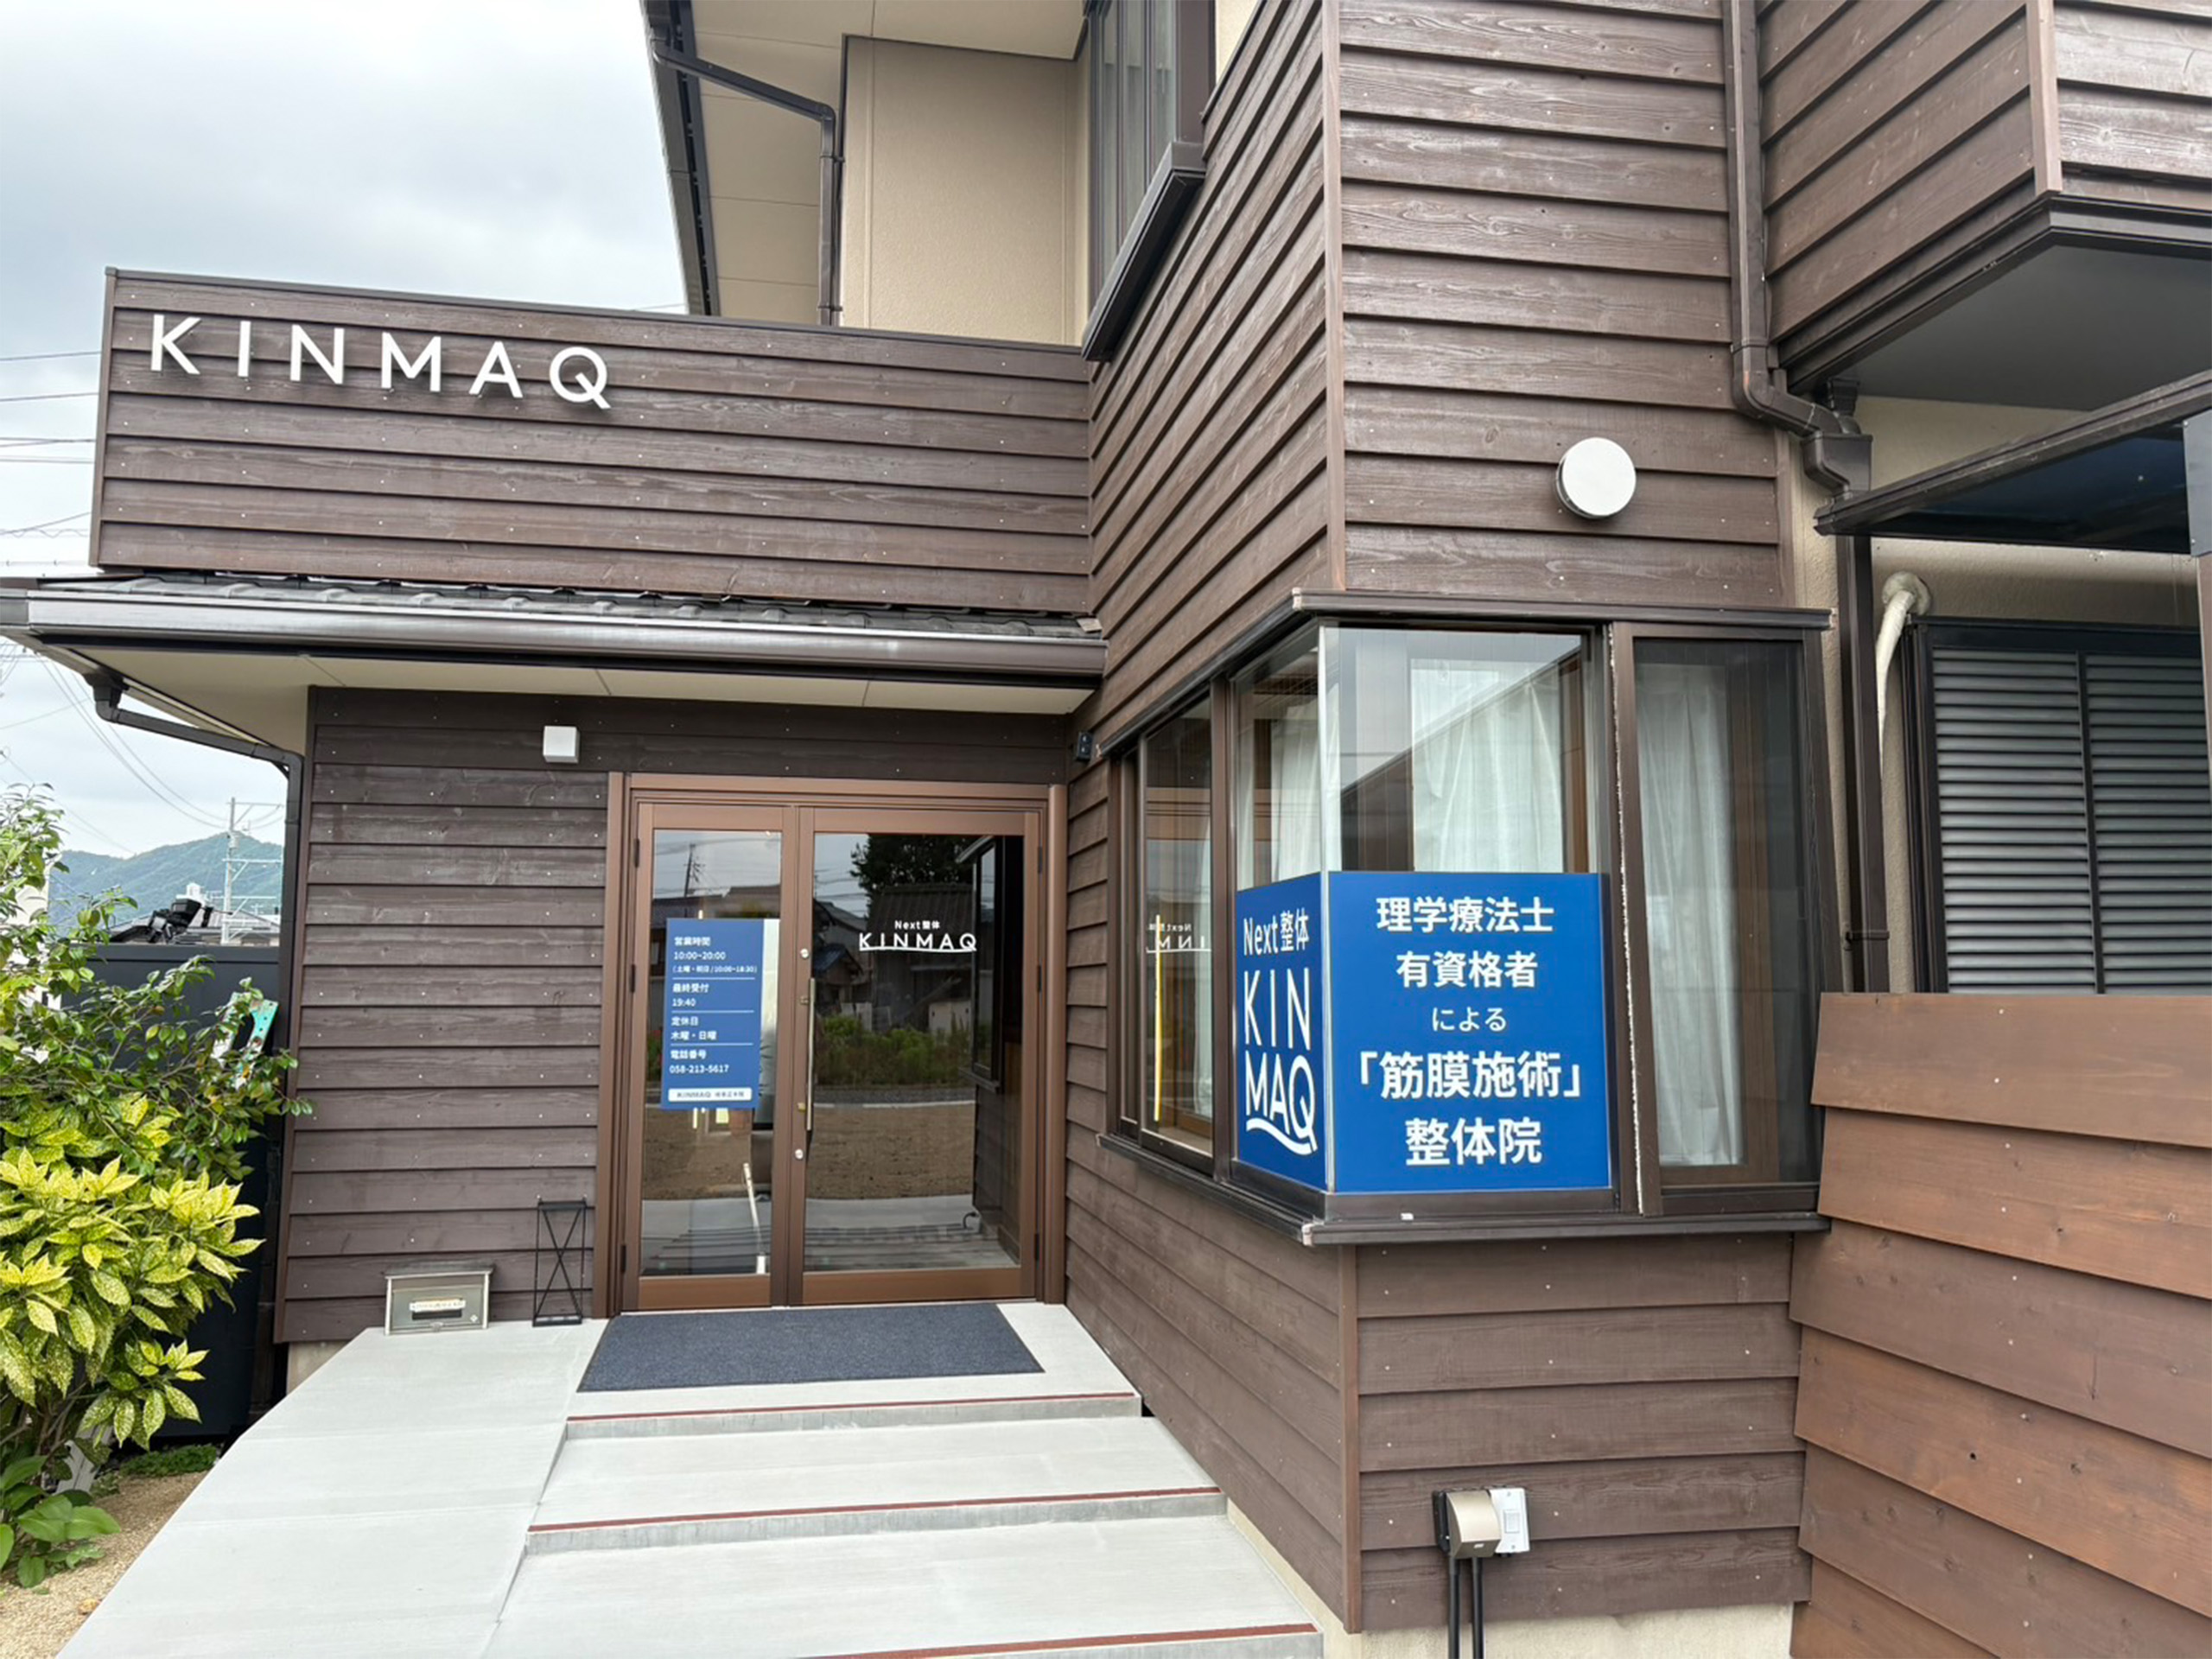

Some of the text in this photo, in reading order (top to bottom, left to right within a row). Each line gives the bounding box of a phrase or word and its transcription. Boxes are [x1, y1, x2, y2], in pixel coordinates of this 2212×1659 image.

[150, 314, 611, 410] KINMAQ
[1376, 896, 1554, 934] 理学療法士
[674, 937, 711, 947] 営業時間
[859, 932, 977, 952] KINMAQ
[1395, 951, 1538, 988] 有資格者
[672, 983, 709, 994] 最終受付
[672, 998, 696, 1007] 19:40
[1243, 967, 1311, 1051] KIN
[671, 1016, 698, 1027] 定休日
[1431, 1007, 1507, 1033] による
[670, 1050, 707, 1060] 電話番号
[669, 1065, 729, 1074] 058-213-5617
[1359, 1051, 1581, 1101] 「筋膜施術」
[1244, 1050, 1319, 1153] MAQ
[1405, 1117, 1542, 1166] 整体院
